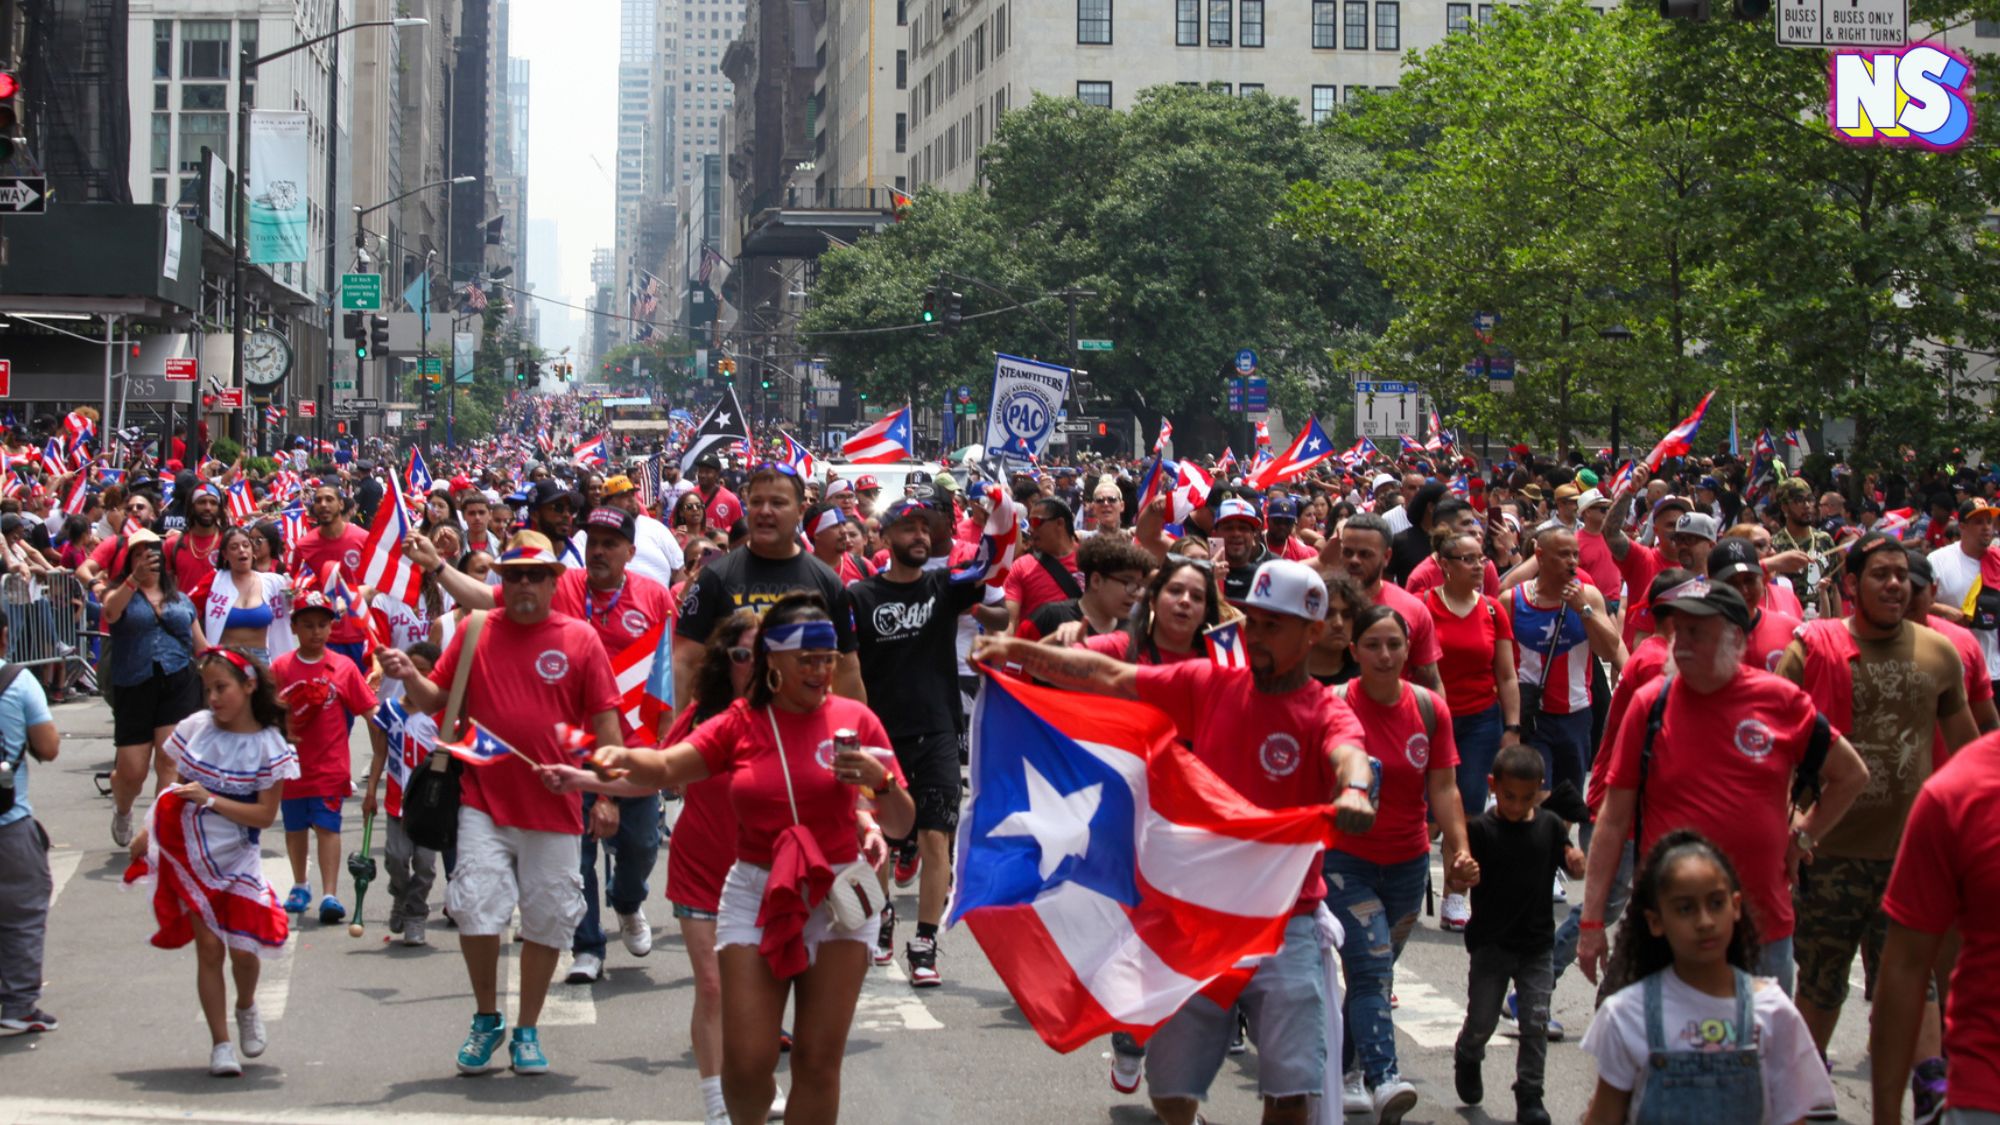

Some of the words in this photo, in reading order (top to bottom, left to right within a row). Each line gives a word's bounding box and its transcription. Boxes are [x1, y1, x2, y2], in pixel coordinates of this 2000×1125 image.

[1785, 9, 1816, 22] BUSES
[1833, 10, 1864, 24] BUSES
[1868, 11, 1894, 25] ONLY
[1788, 26, 1813, 39] ONLY
[1825, 27, 1833, 40] &
[1838, 28, 1866, 41] RIGHT
[1870, 29, 1902, 42] TURNS
[0, 188, 29, 202] WAY
[1000, 366, 1063, 392] STEAMFITTERS
[127, 378, 156, 396] 785
[1008, 403, 1043, 432] PAC
[164, 515, 187, 527] NYP
